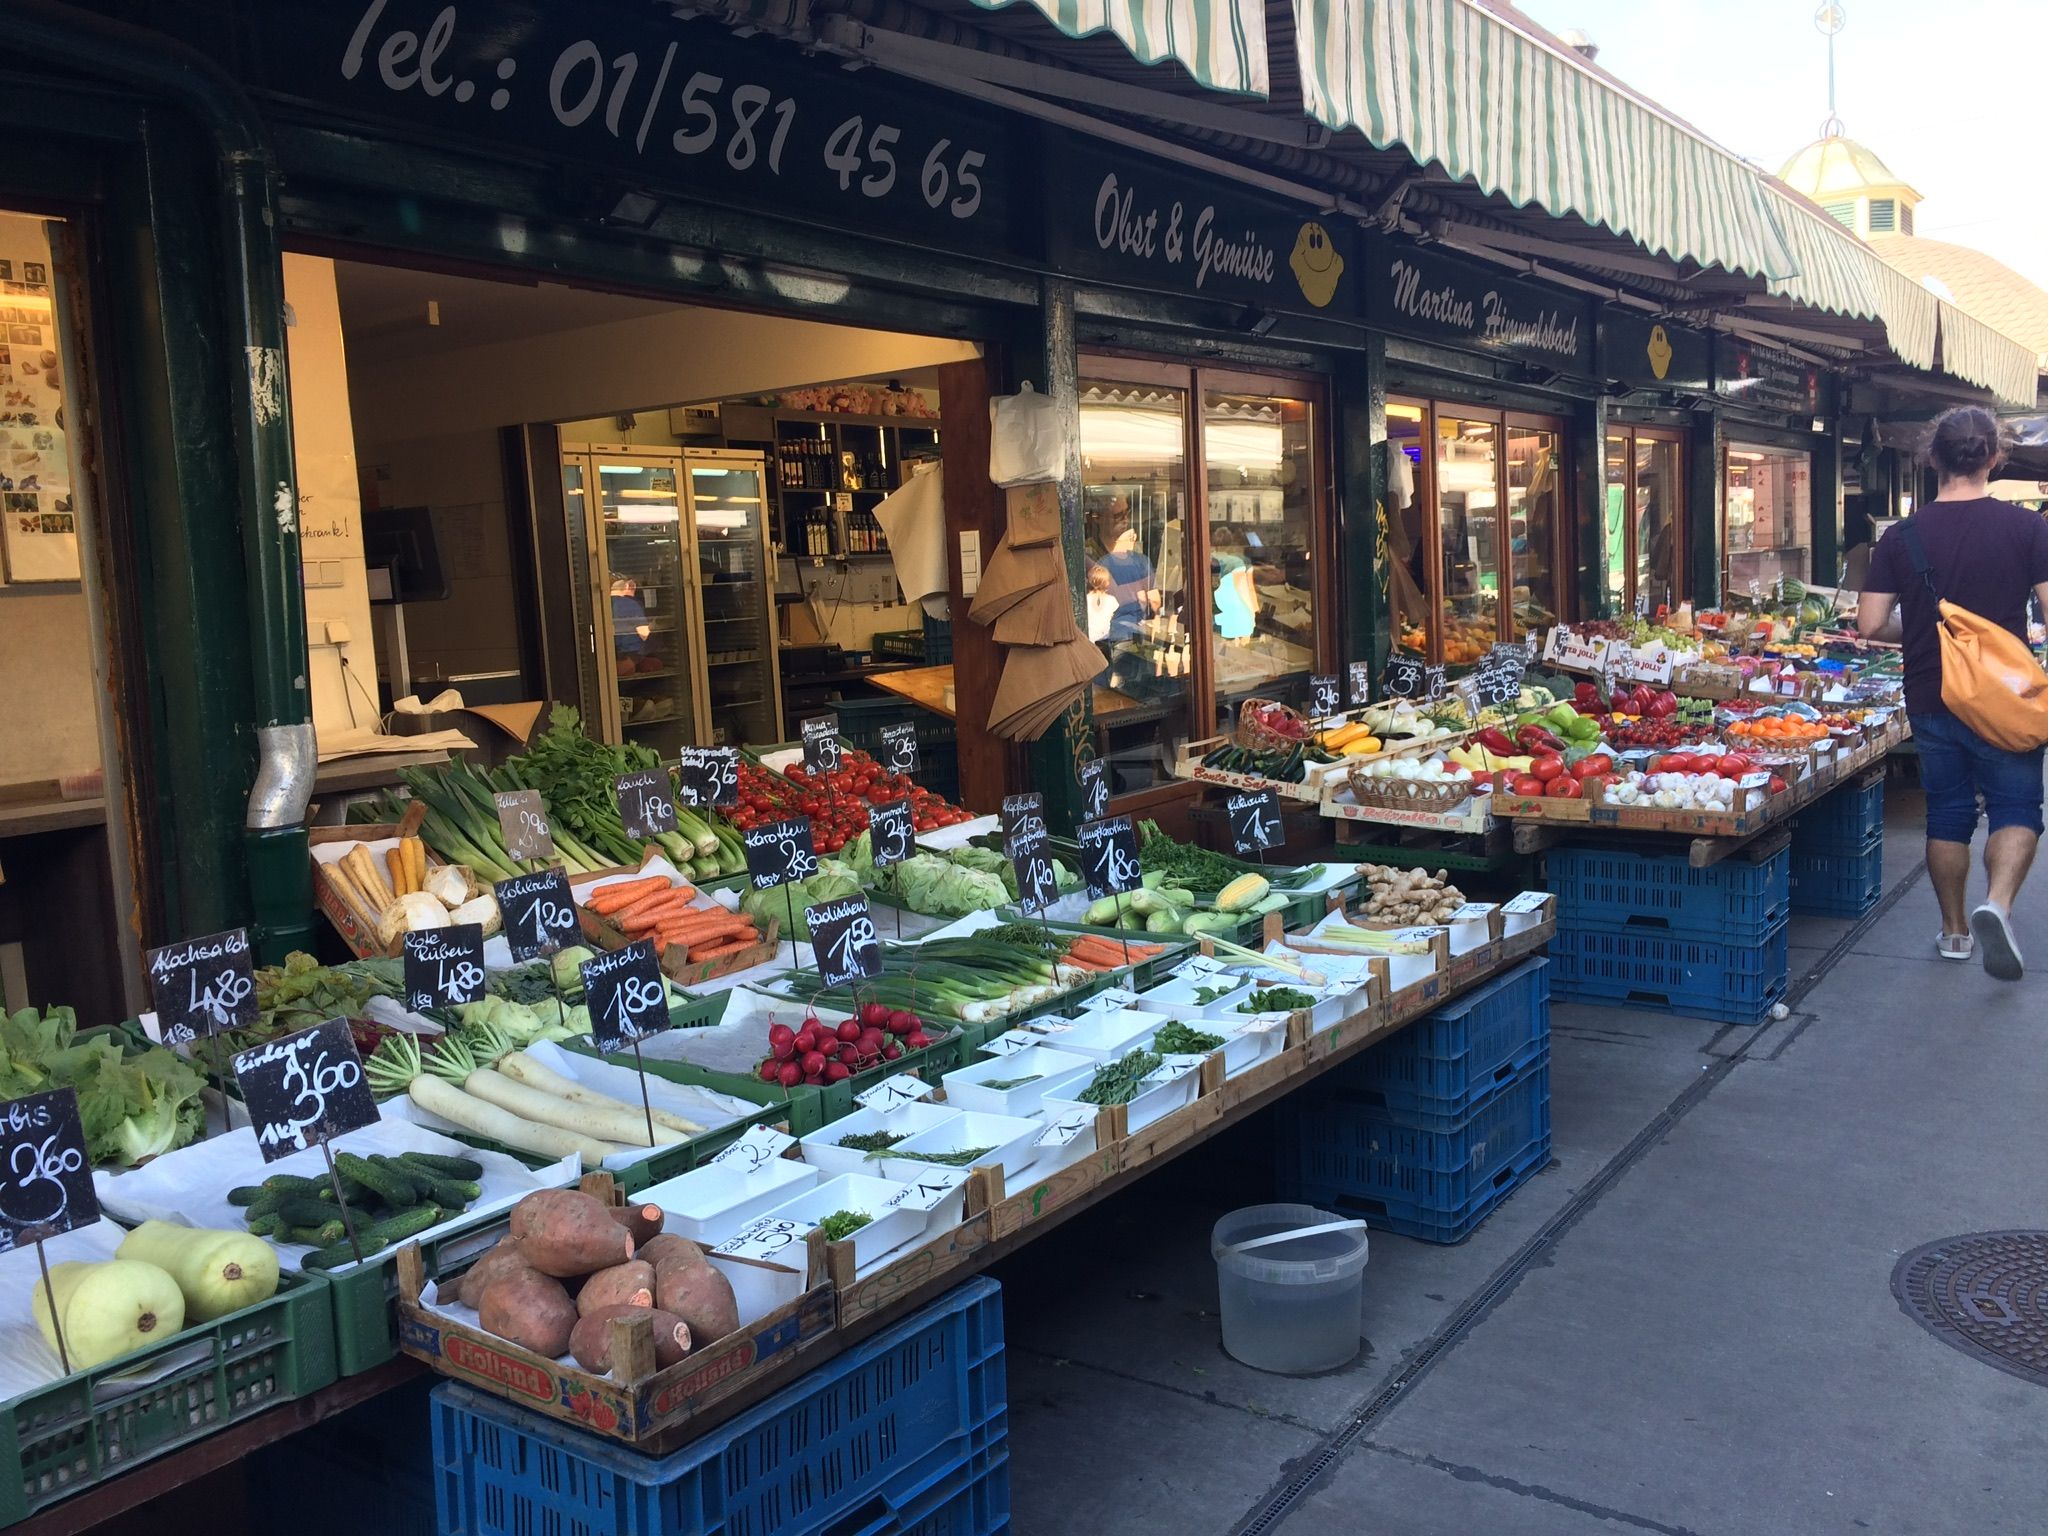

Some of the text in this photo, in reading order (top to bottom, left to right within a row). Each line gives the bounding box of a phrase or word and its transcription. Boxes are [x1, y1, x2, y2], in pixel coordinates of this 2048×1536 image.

[550, 40, 795, 174] 01/581
[823, 115, 900, 198] 45
[921, 139, 986, 218] 65
[1095, 172, 1274, 289] Obst & Gemüse
[1390, 259, 1578, 356] Martina Himmelsbach
[1577, 648, 1598, 661] JOLLY
[1641, 661, 1663, 673] JOLLY
[745, 822, 808, 849] Karotten
[414, 943, 474, 962] Rüben
[583, 946, 646, 979] Rettich
